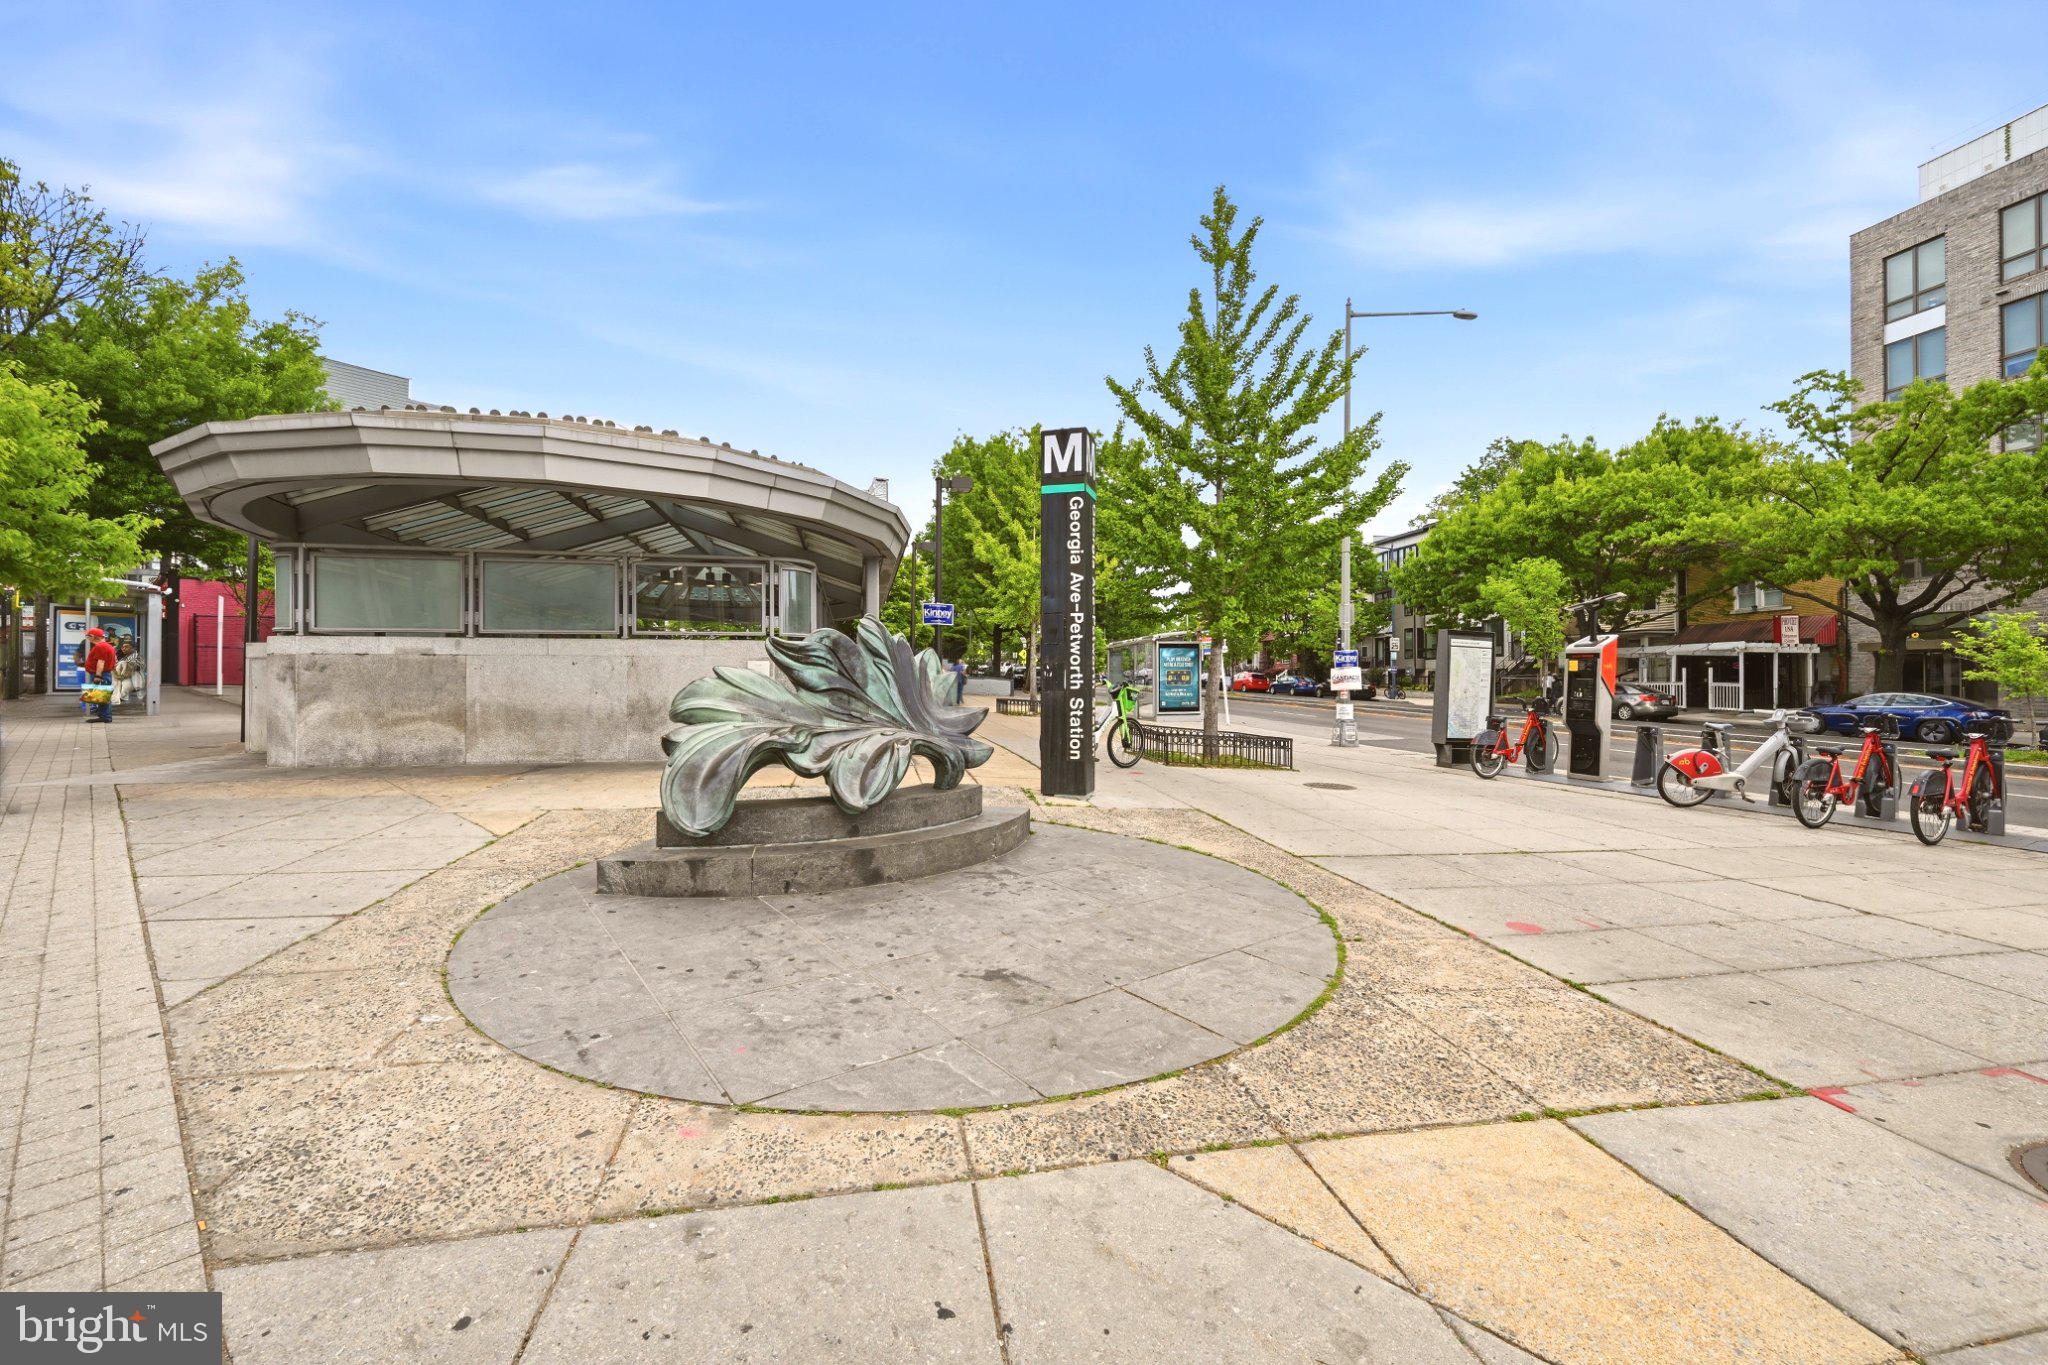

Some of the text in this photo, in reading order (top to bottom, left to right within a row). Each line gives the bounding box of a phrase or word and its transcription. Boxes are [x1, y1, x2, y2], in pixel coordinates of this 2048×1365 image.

[1043, 432, 1083, 474] M
[1067, 496, 1085, 760] Georgia Ave-Petworth Station
